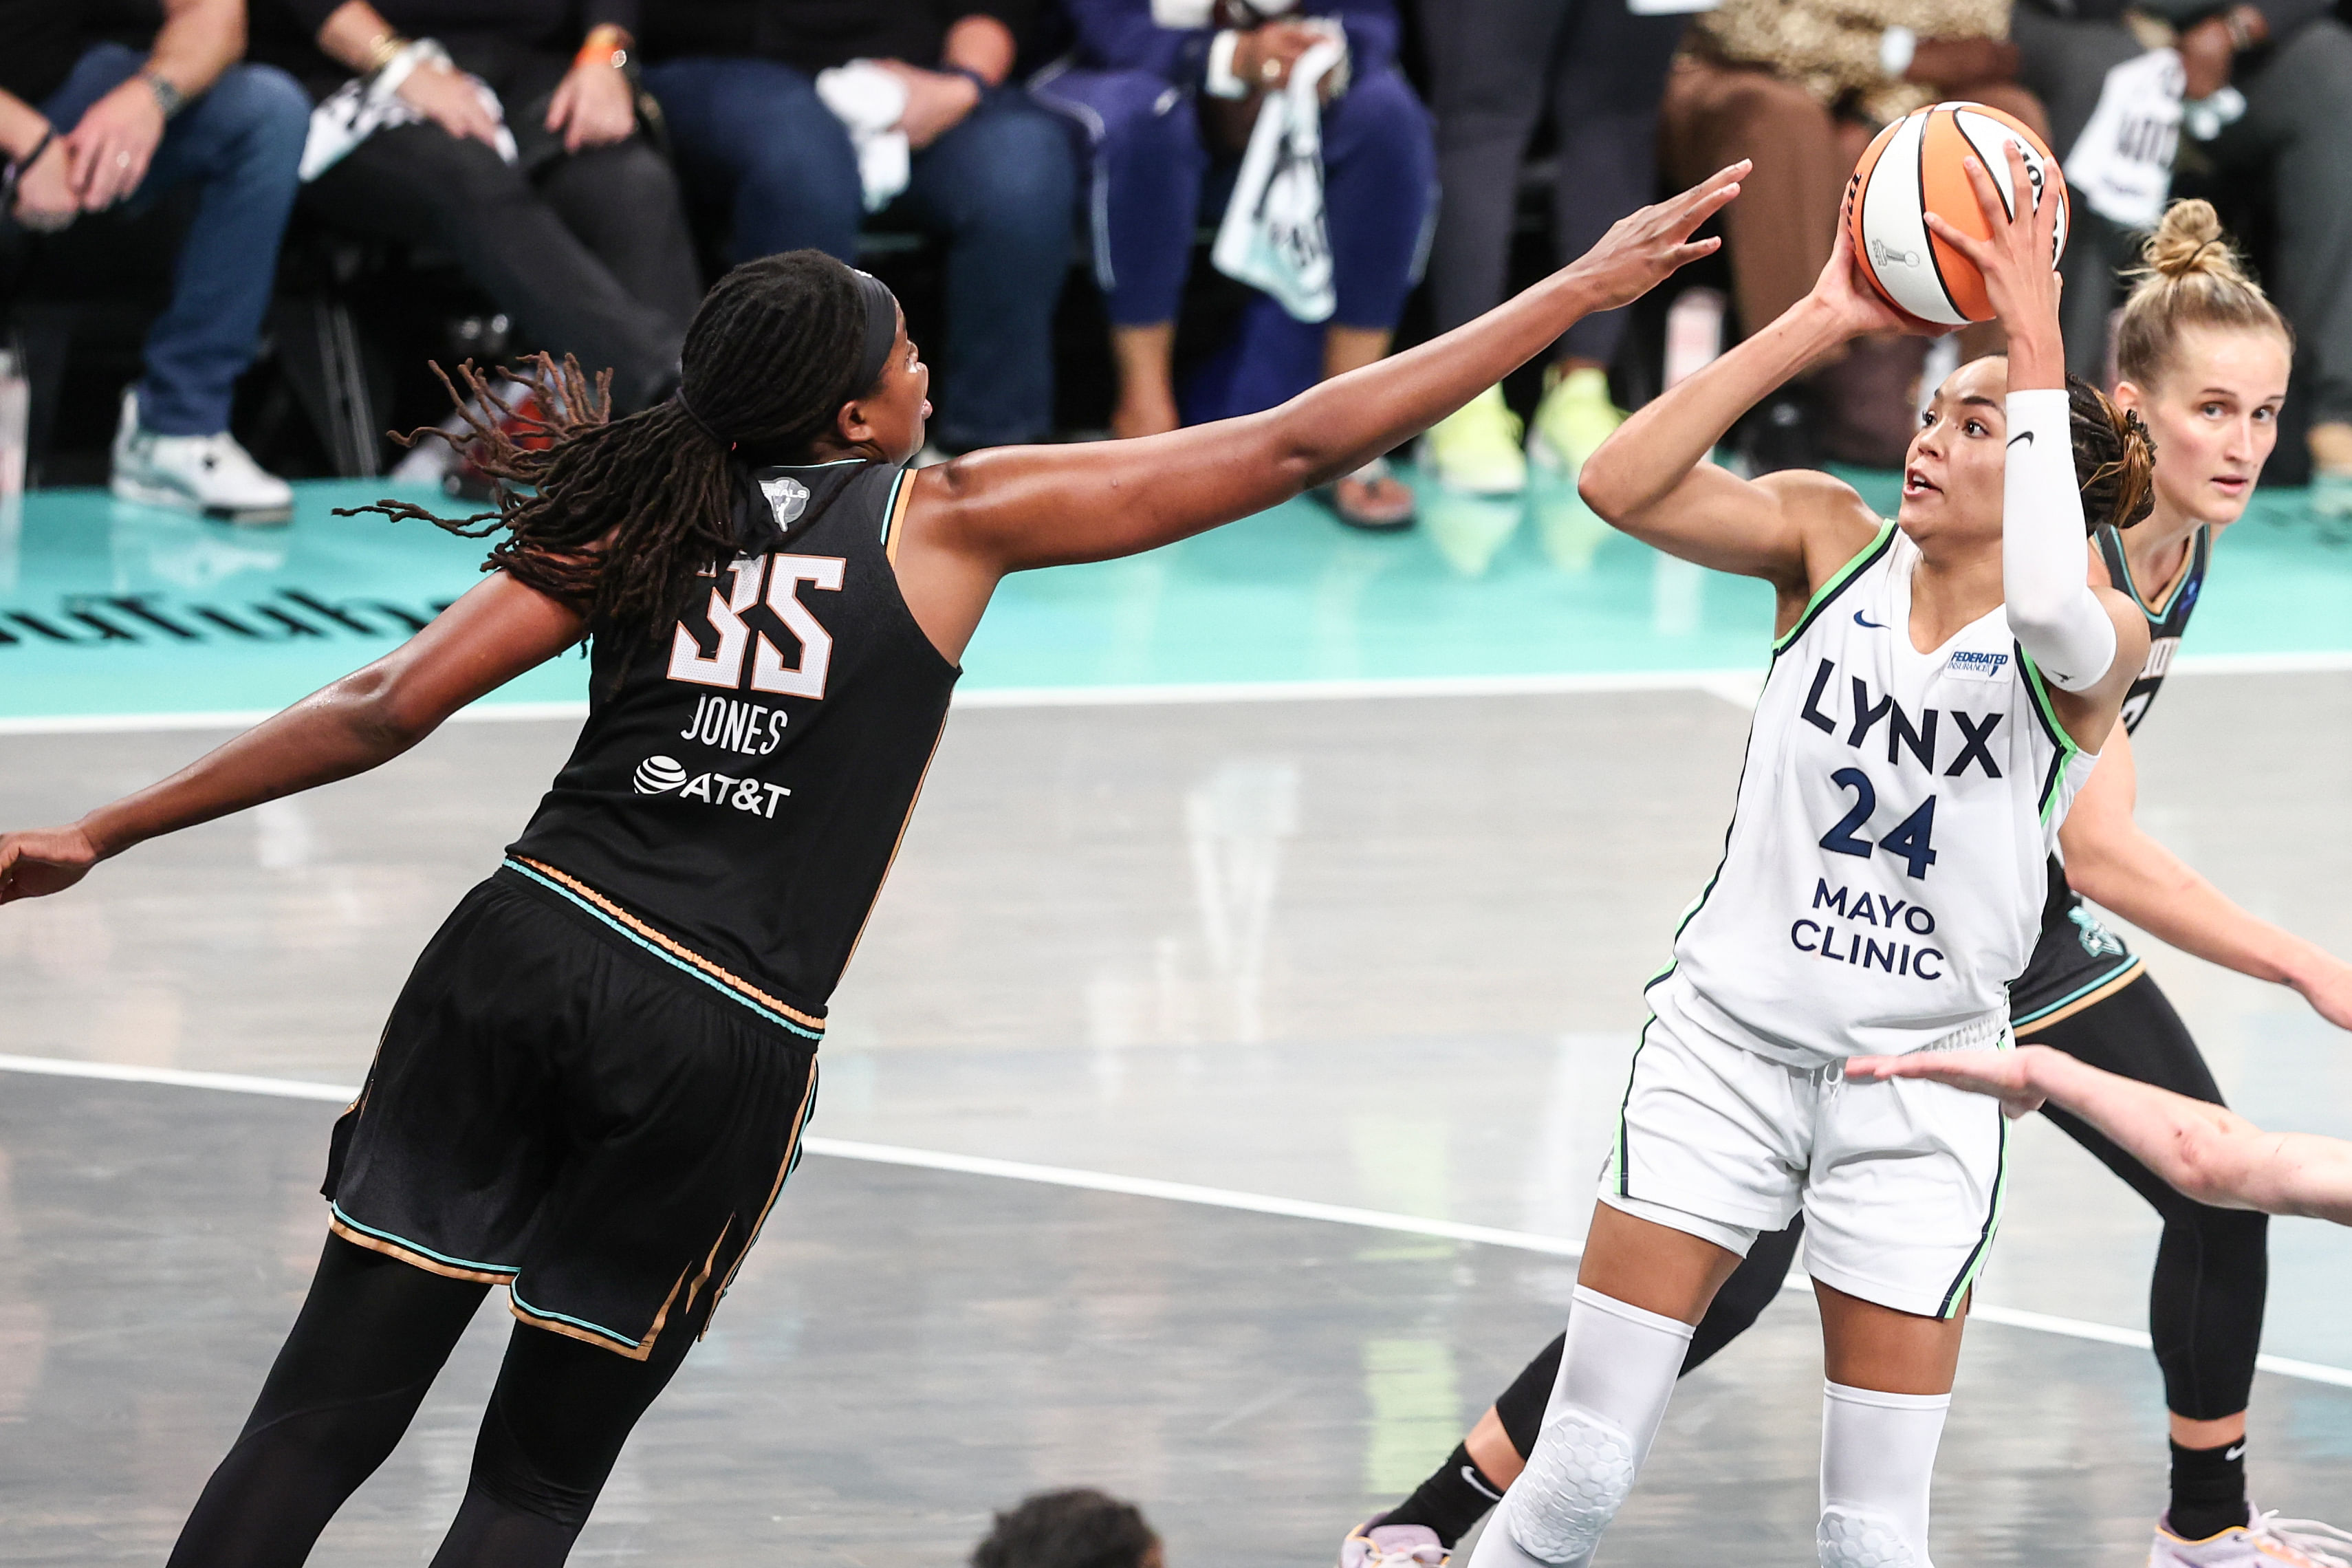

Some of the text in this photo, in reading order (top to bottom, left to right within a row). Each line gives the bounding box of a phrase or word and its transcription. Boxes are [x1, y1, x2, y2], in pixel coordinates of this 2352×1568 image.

[0, 587, 462, 646] uTub
[666, 549, 847, 701] 35
[1947, 661, 1988, 673] INSURANCE
[1951, 651, 2009, 665] FEDERATED
[680, 693, 788, 755] JONES
[1800, 657, 2004, 778] LYNX
[679, 772, 792, 819] AT&T
[1819, 767, 1937, 881] 24
[1812, 877, 1935, 935] MAYO
[1791, 919, 1945, 980] CLINIC
